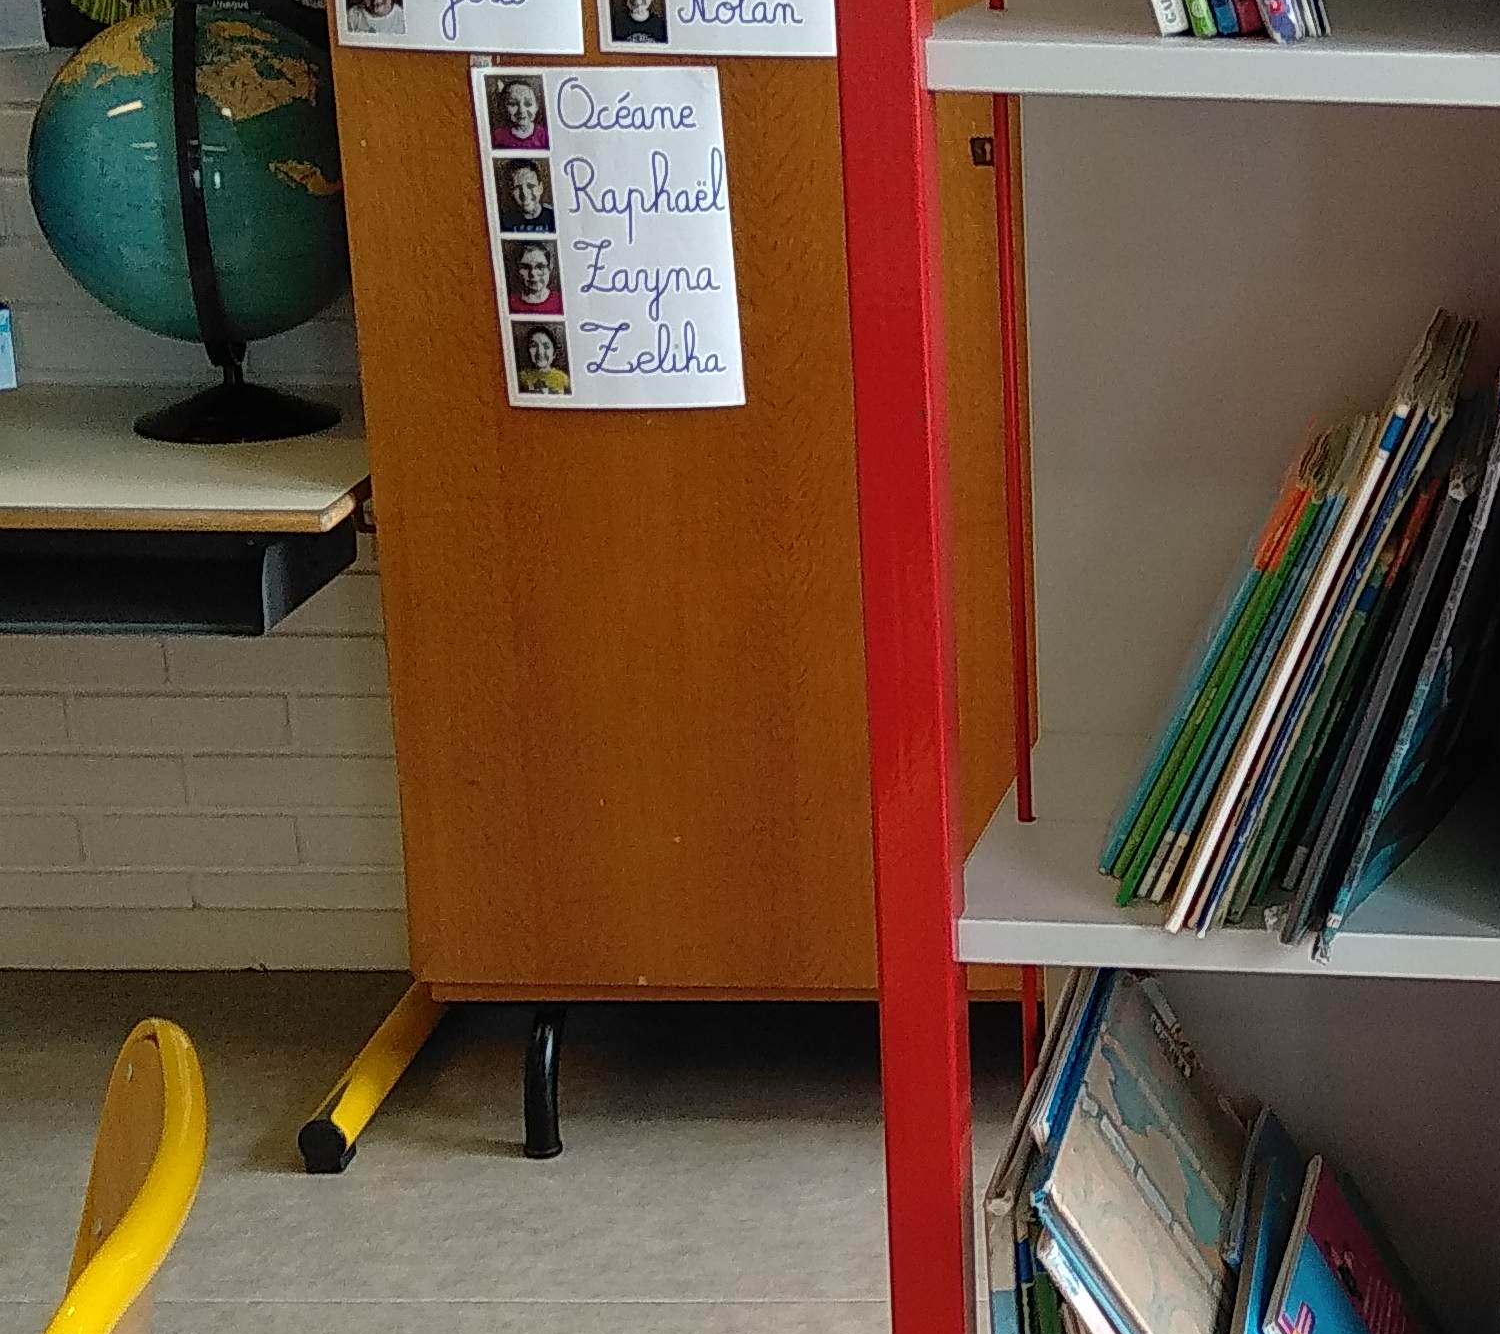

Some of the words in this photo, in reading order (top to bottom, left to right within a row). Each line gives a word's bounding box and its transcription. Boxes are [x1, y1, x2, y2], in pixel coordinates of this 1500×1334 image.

[557, 76, 696, 129] Océane
[564, 147, 726, 244] Raphaël
[573, 239, 720, 321] Zayna
[580, 320, 727, 374] Zeliha
